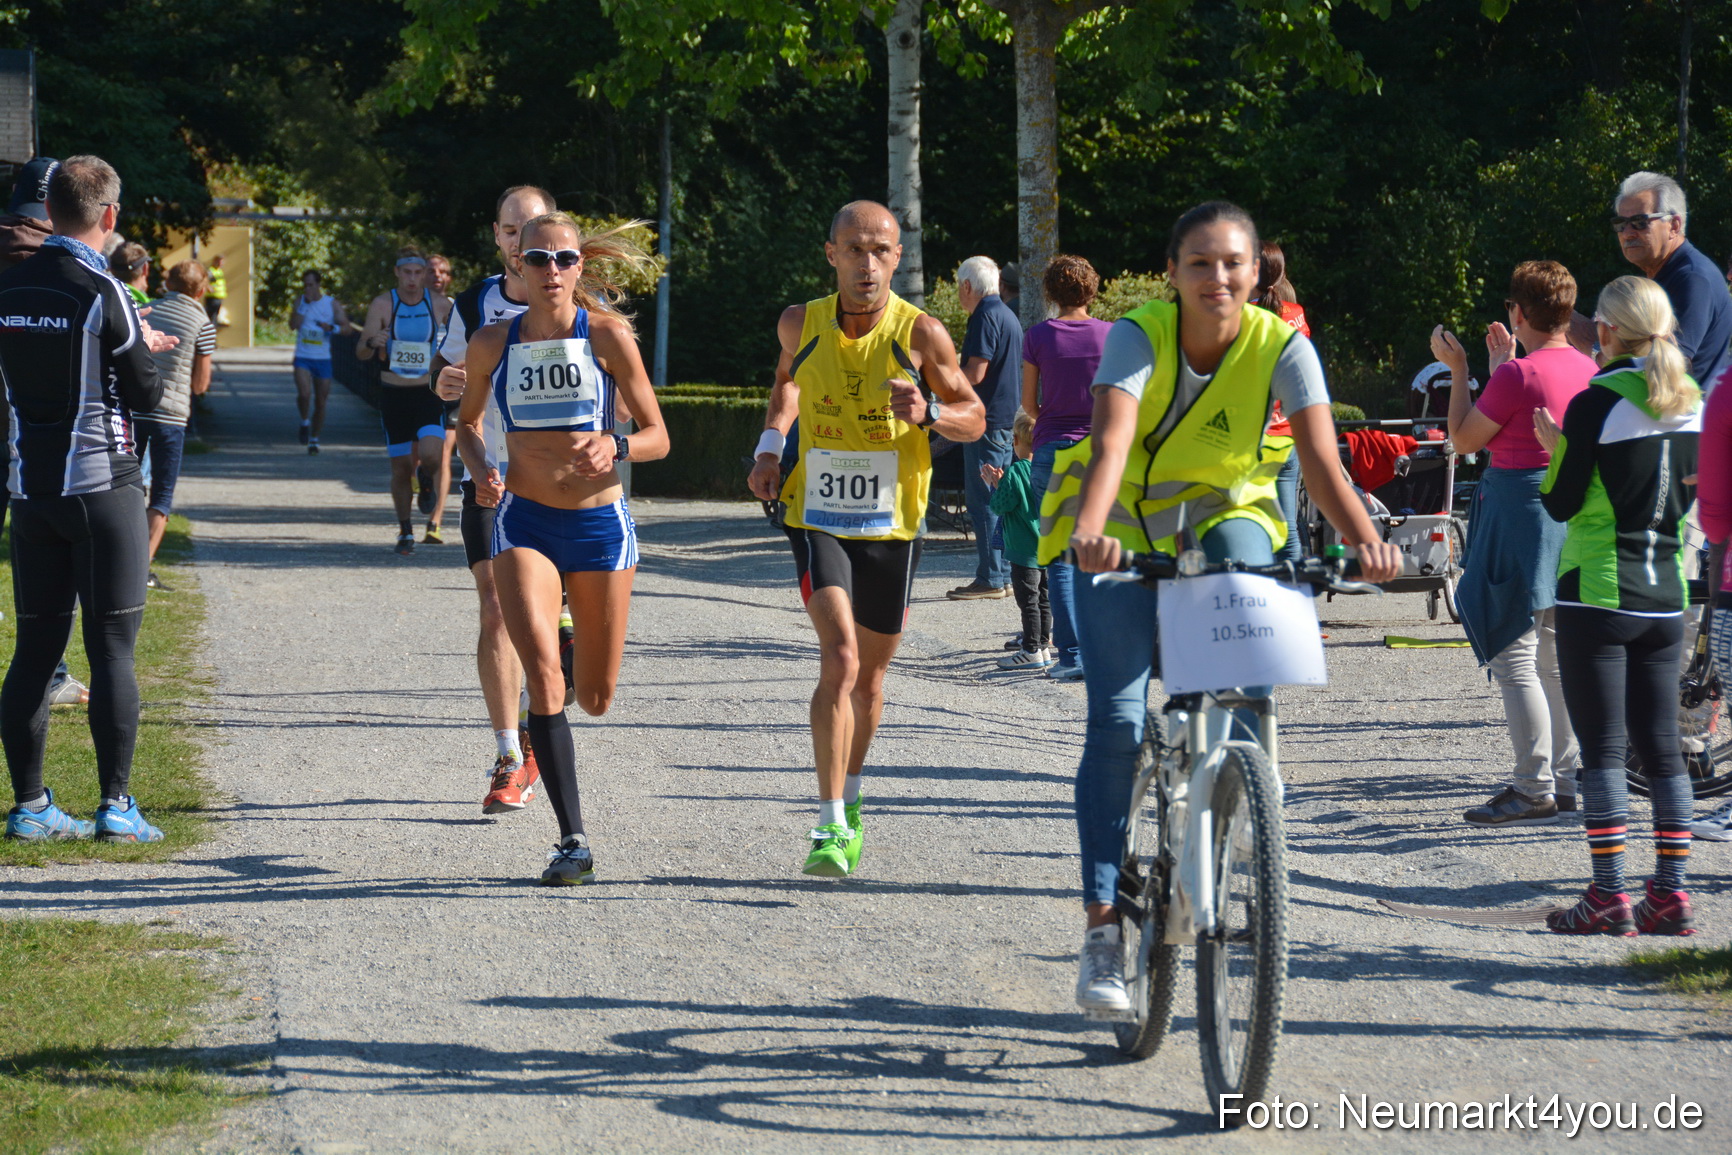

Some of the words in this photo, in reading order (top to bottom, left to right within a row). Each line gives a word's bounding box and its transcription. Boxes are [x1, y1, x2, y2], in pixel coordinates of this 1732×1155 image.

[396, 351, 425, 364] 2393
[531, 347, 567, 359] BOCK
[518, 362, 582, 392] 3100
[543, 392, 571, 400] Neumarkt
[824, 425, 833, 436] &
[835, 427, 843, 437] S
[870, 432, 892, 440] ELIO
[831, 457, 871, 468] BOCK
[818, 472, 880, 500] 3101
[823, 501, 841, 509] PARTL
[842, 502, 870, 510] Neumarkt
[1213, 593, 1267, 611] 1.Frau
[1211, 623, 1275, 642] 10.5km
[106, 812, 134, 828] salomon
